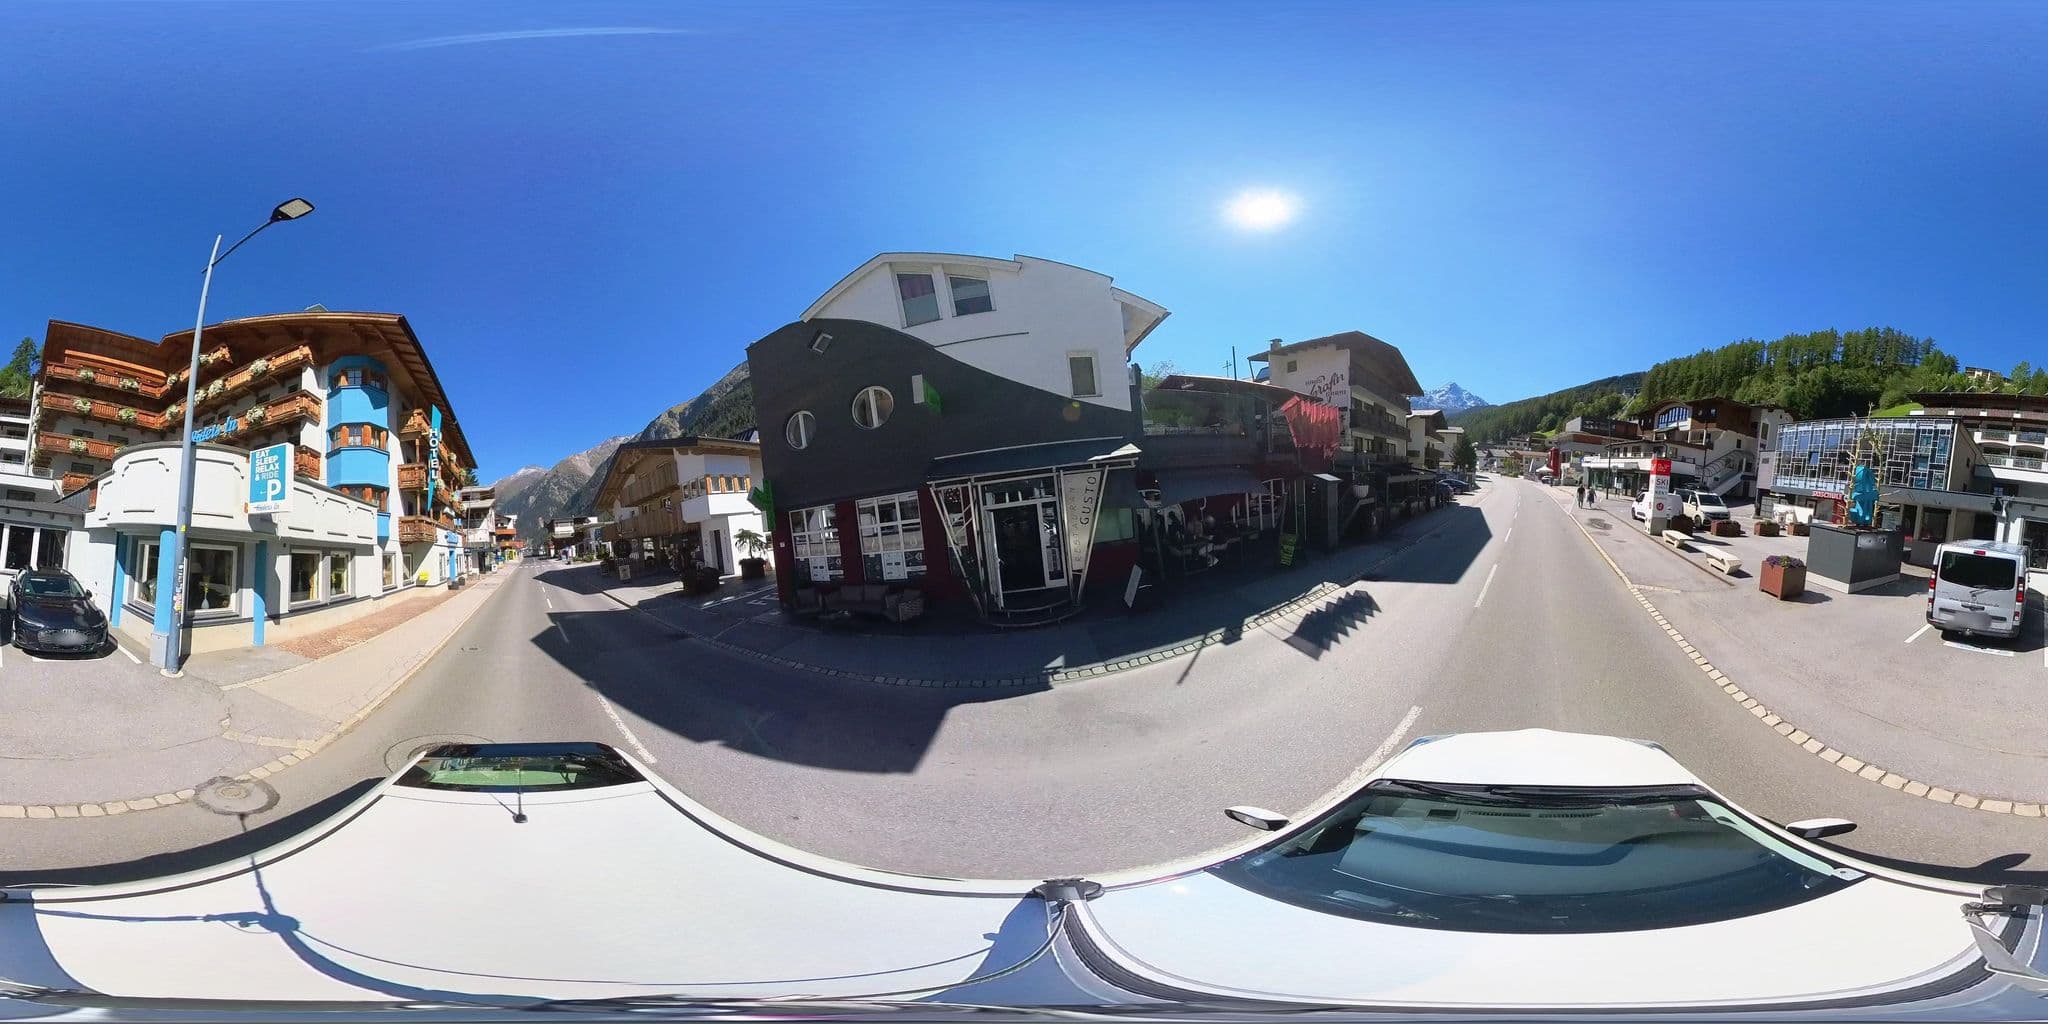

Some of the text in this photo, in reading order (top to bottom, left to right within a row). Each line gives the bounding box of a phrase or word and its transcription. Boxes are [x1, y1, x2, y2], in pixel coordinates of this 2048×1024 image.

[255, 449, 270, 459] EAT
[429, 428, 439, 479] HOTEL
[255, 455, 279, 466] SLEEP
[255, 462, 280, 474] RELAX
[261, 470, 280, 480] RIDE
[266, 479, 281, 502] P
[1068, 476, 1097, 562] RESTAURAN GUSTO
